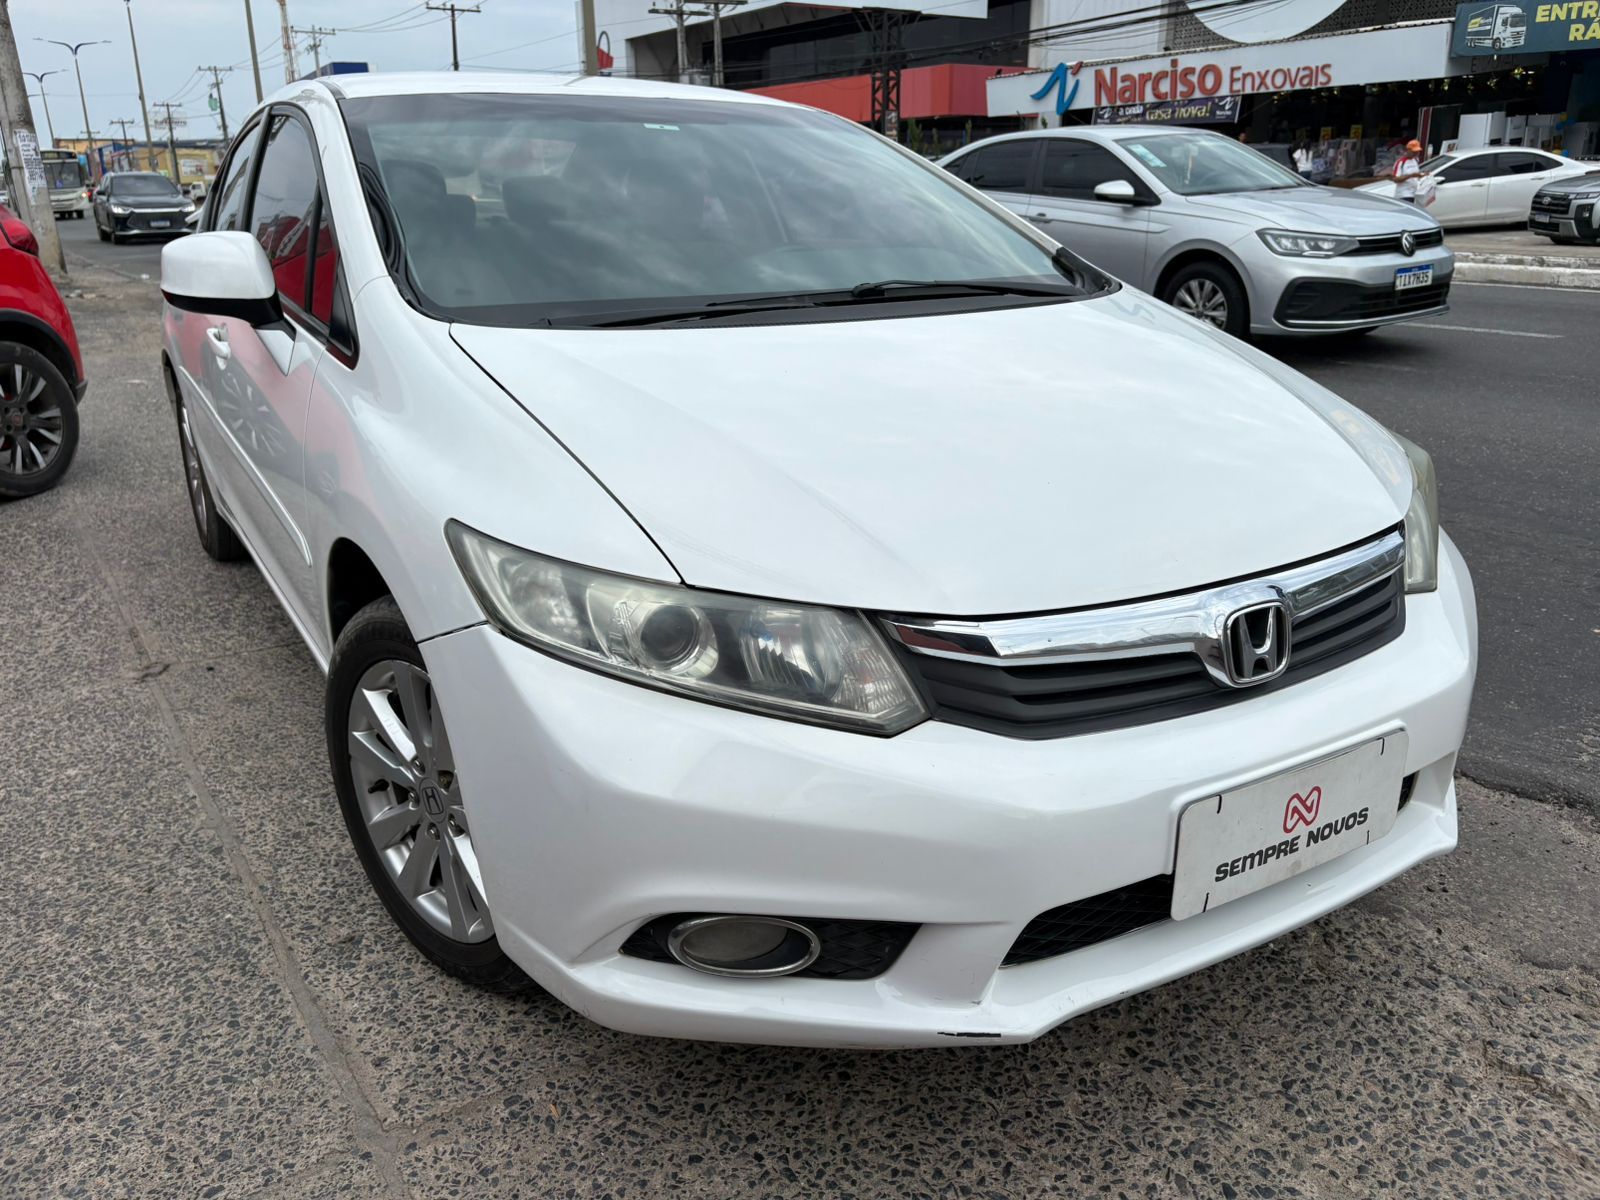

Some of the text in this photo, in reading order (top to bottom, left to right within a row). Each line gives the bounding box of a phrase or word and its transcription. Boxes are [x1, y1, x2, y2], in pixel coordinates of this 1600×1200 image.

[1535, 1, 1600, 23] ENTR
[1094, 59, 1332, 106] Narciso Enxovais
[1215, 835, 1301, 882] SEMPRE
